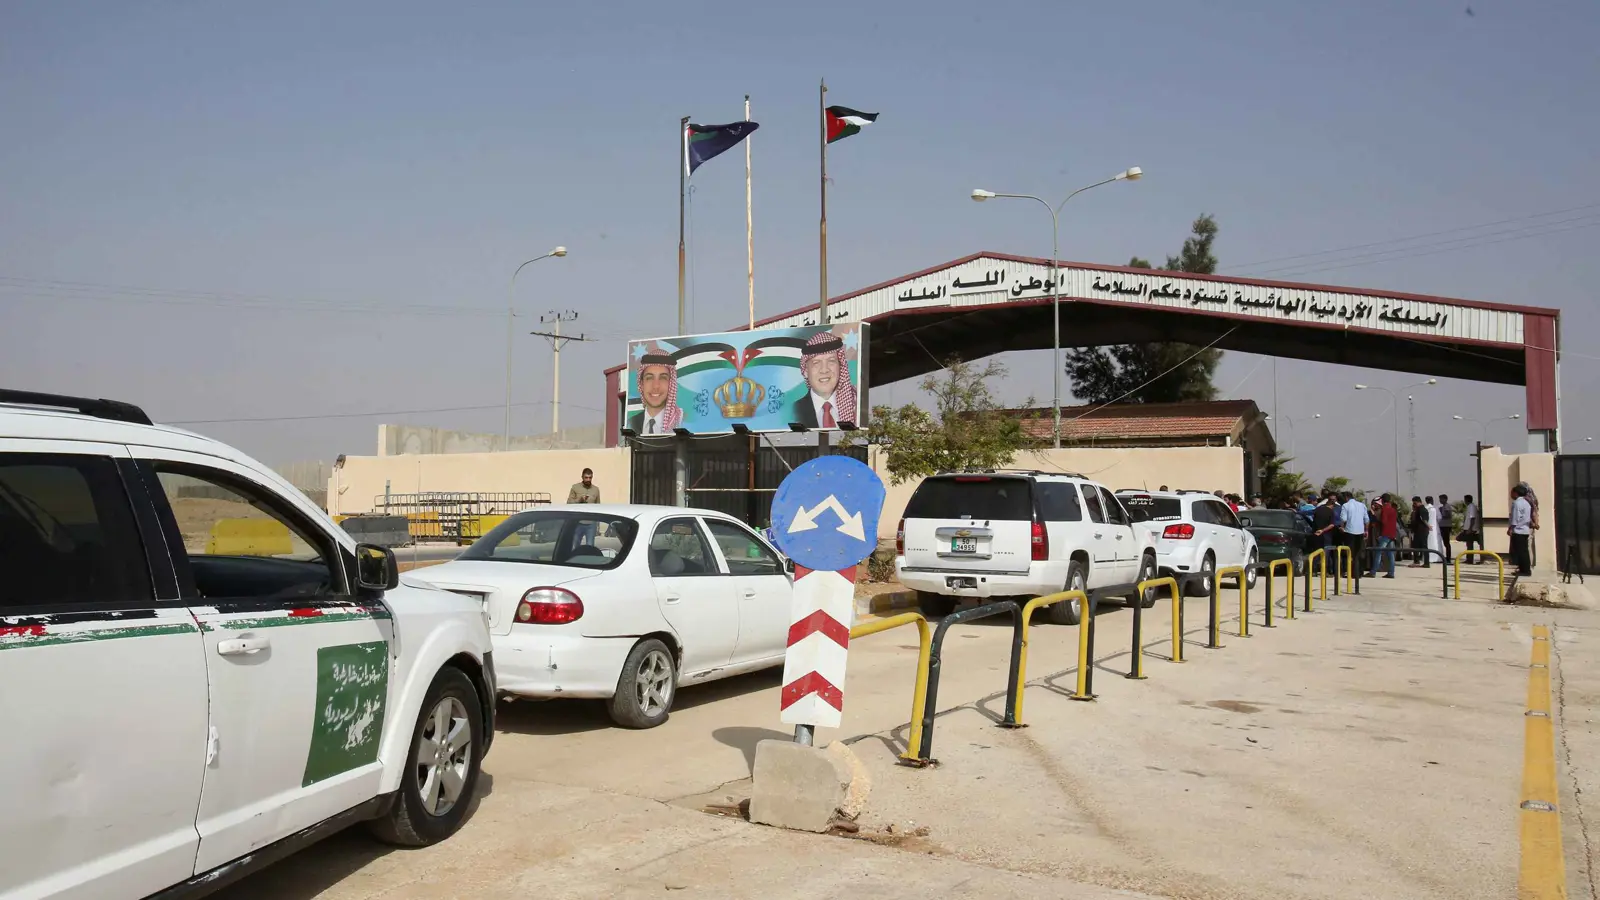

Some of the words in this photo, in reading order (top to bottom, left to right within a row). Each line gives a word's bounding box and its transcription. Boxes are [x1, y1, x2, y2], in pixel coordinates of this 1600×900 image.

[952, 269, 1005, 289] الله
[1092, 276, 1148, 297] السلامة
[898, 285, 946, 302] الملك
[1233, 291, 1307, 315] الهاشمية
[1378, 304, 1448, 330] المملكة
